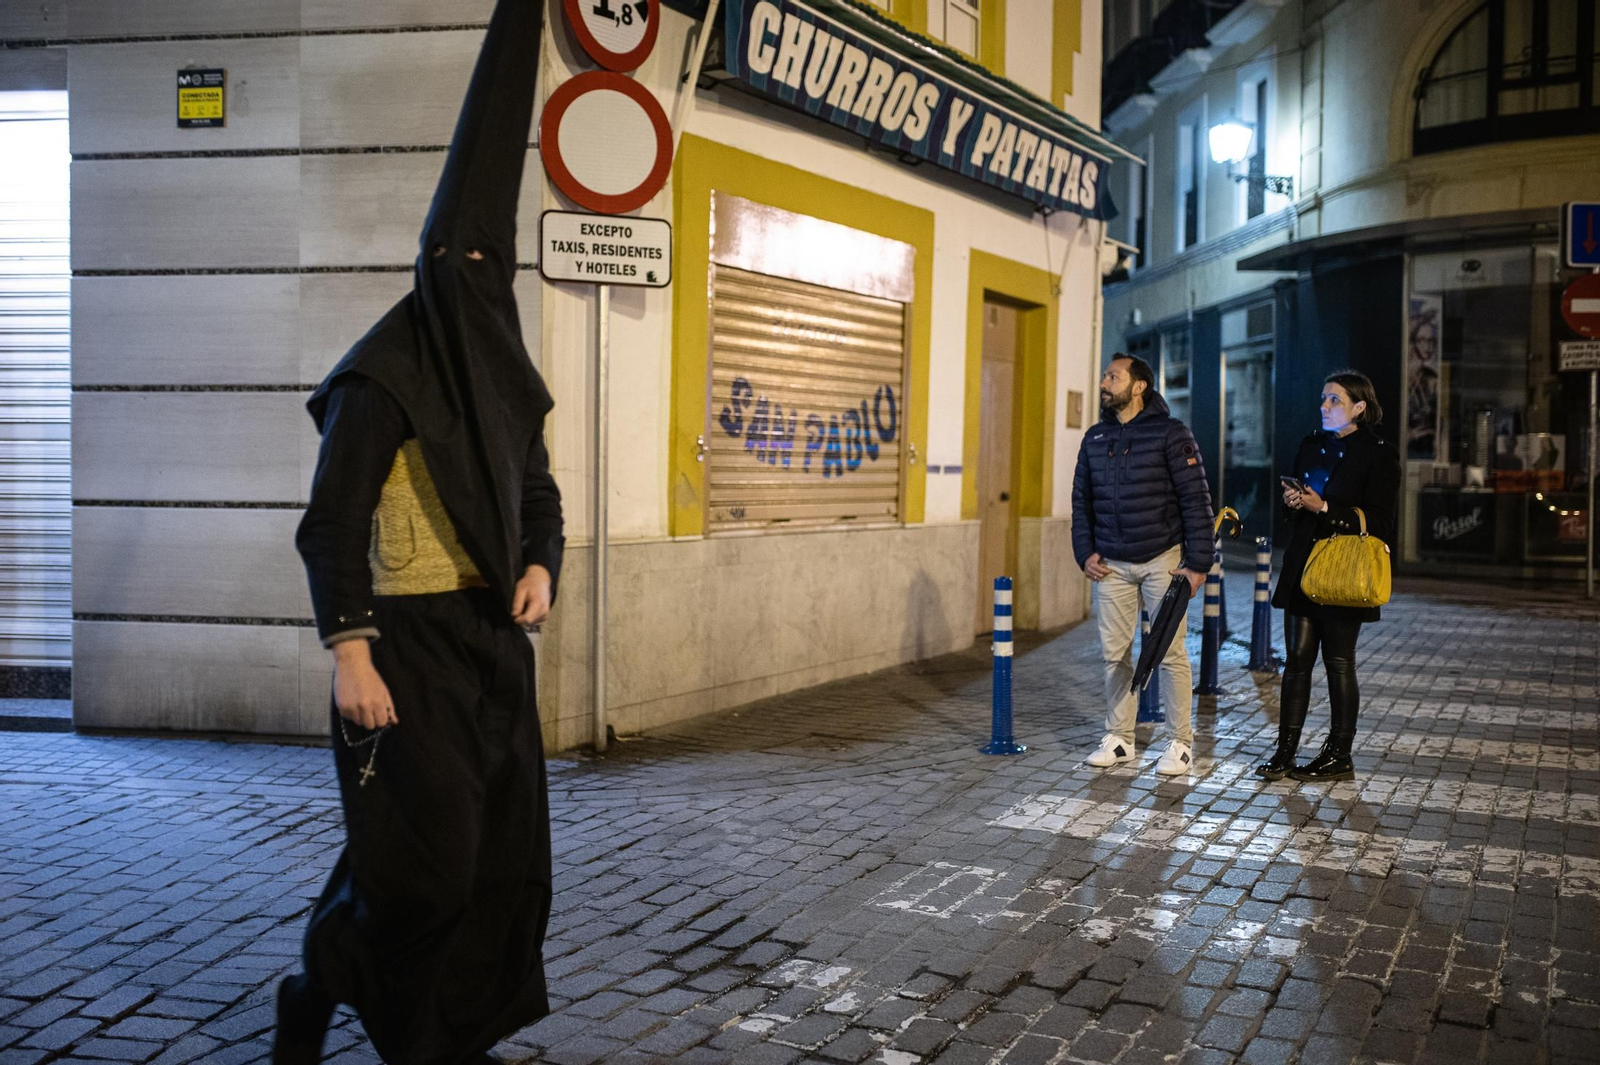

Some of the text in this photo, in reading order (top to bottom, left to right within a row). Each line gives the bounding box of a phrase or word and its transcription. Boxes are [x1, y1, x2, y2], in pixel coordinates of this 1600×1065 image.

[747, 1, 1098, 210] CHURROS Y PATATAS
[580, 223, 633, 238] EXCEPTO
[551, 240, 662, 260] TAXIS, RESIDENTES
[575, 261, 637, 276] Y HOTELES
[719, 376, 897, 478] SAN PABLO
